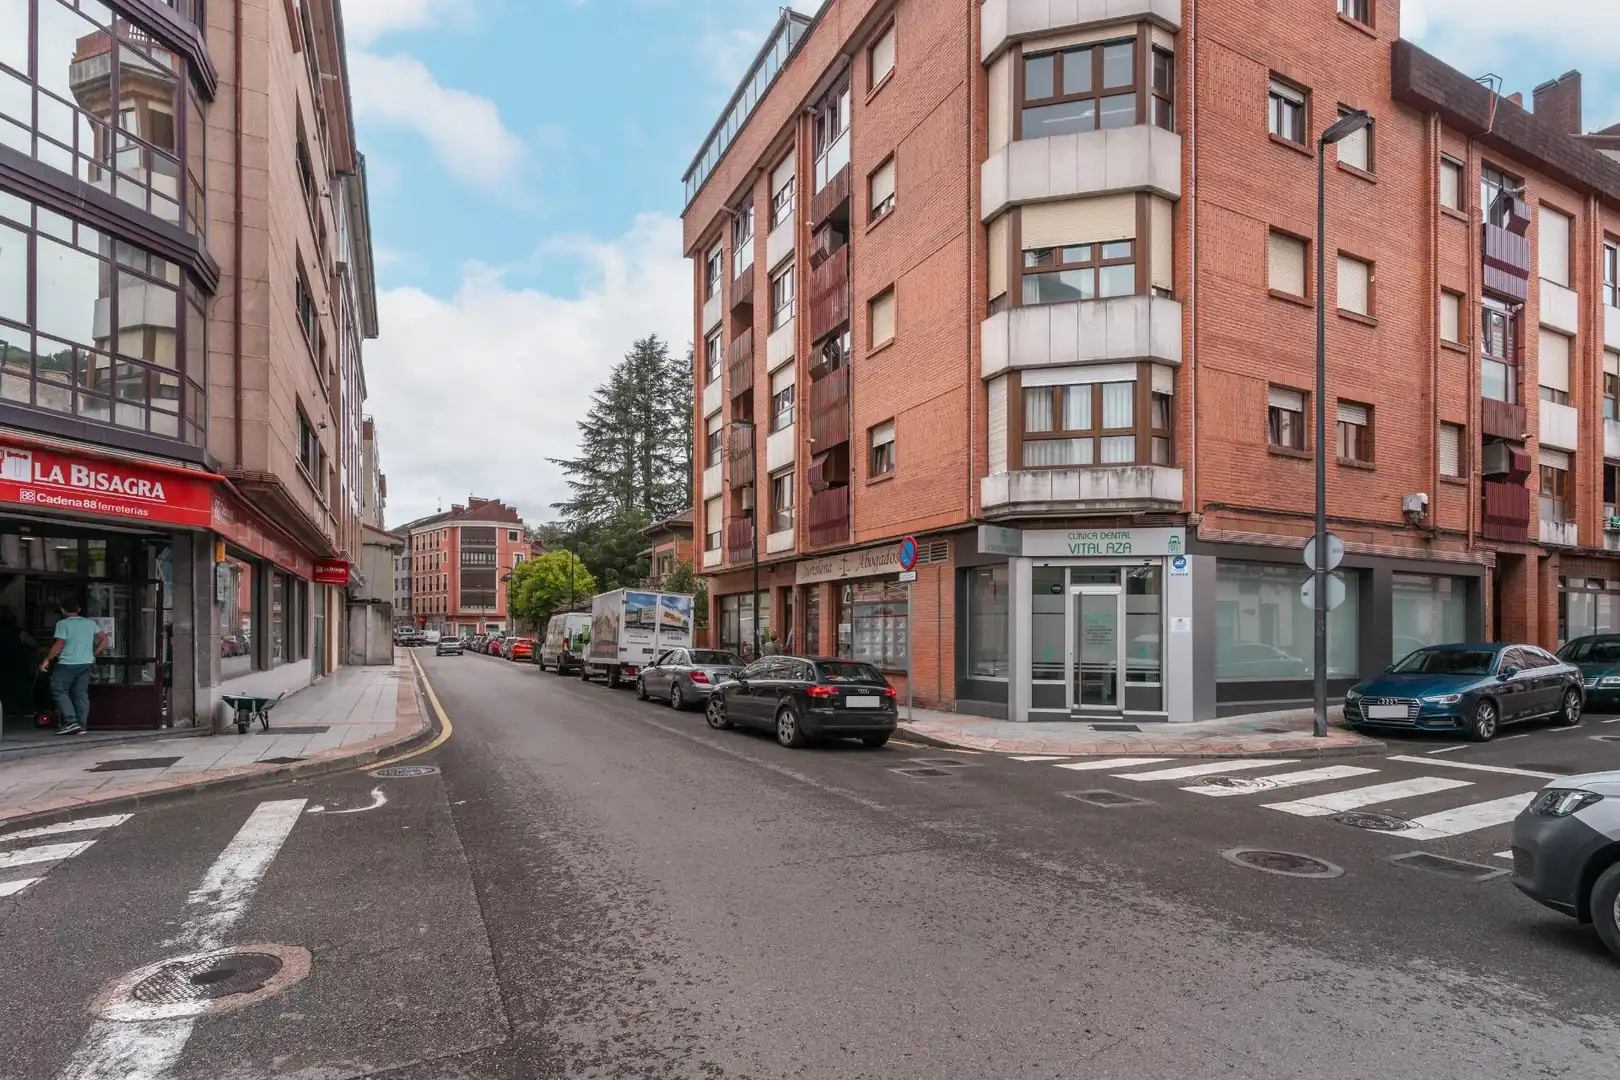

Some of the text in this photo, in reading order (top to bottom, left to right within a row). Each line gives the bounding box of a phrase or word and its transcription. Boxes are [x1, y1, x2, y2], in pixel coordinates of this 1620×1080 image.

[34, 462, 165, 499] LA BISAGRA
[855, 547, 900, 572] Abogados
[1068, 542, 1131, 554] VITAL AZA
